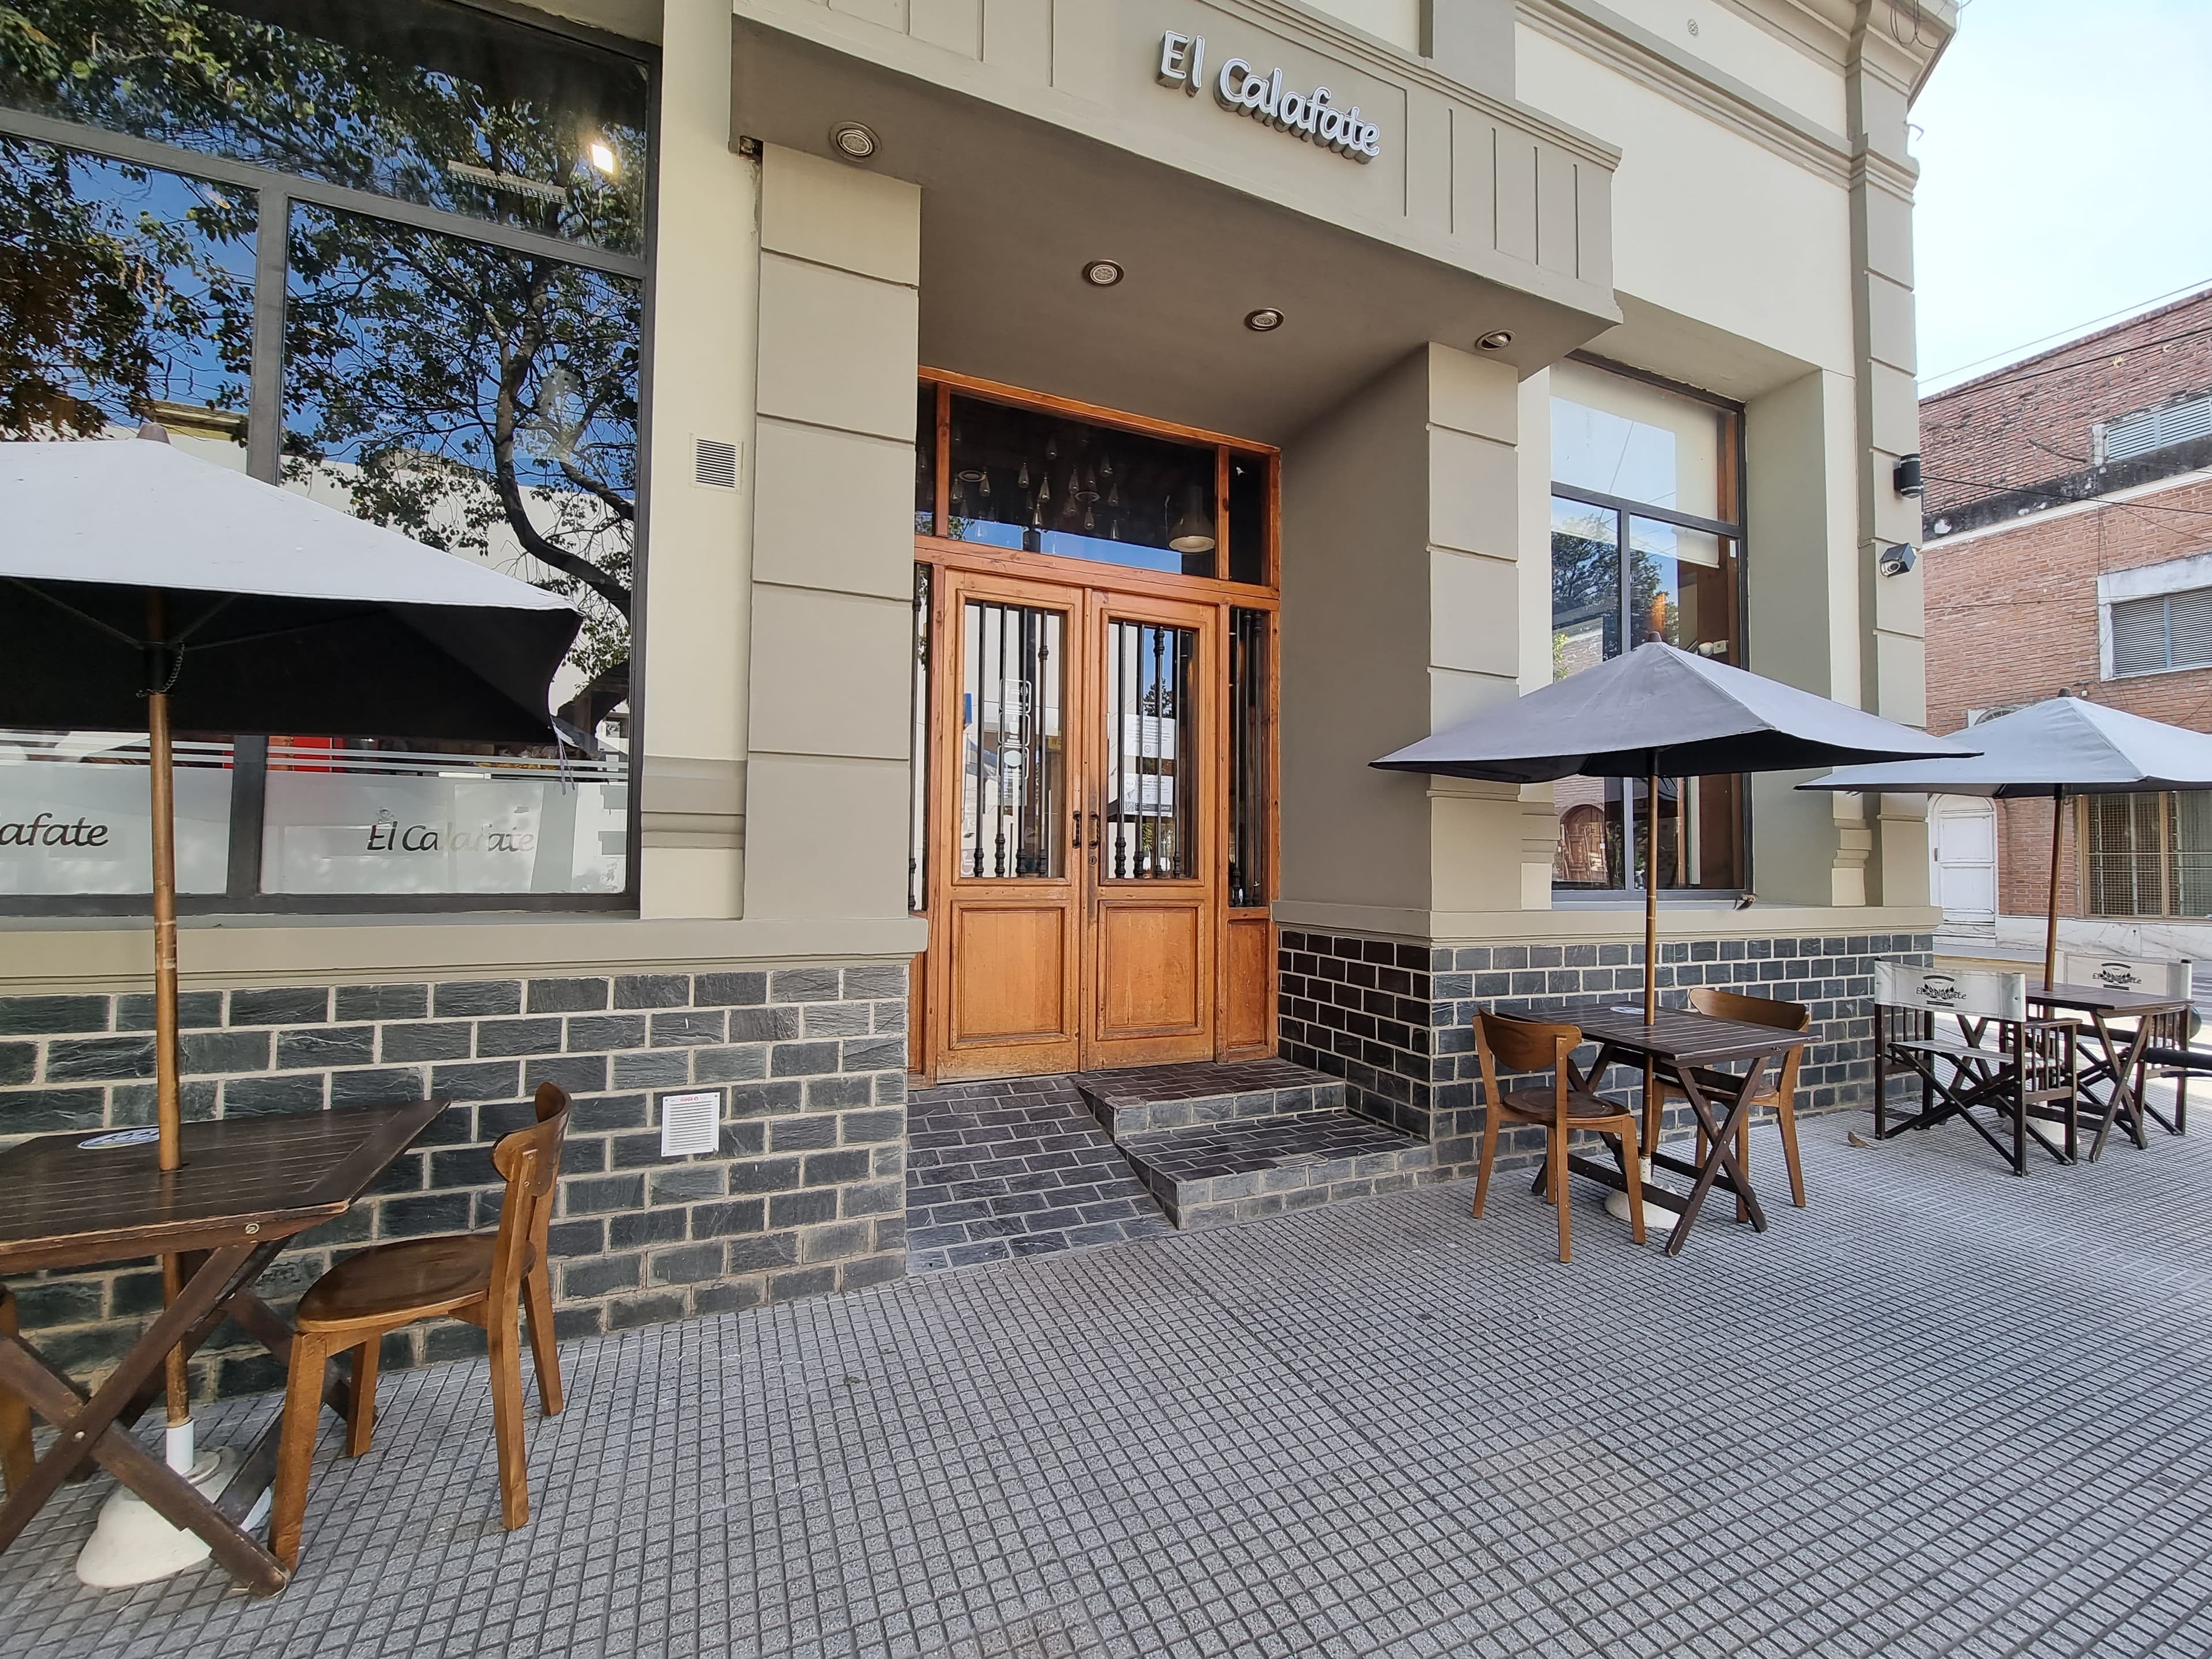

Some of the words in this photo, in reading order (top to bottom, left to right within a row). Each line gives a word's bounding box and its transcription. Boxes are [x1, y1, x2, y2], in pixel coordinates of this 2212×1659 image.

[1160, 30, 1206, 91] El
[1217, 58, 1380, 159] Calafate
[366, 821, 397, 851] El
